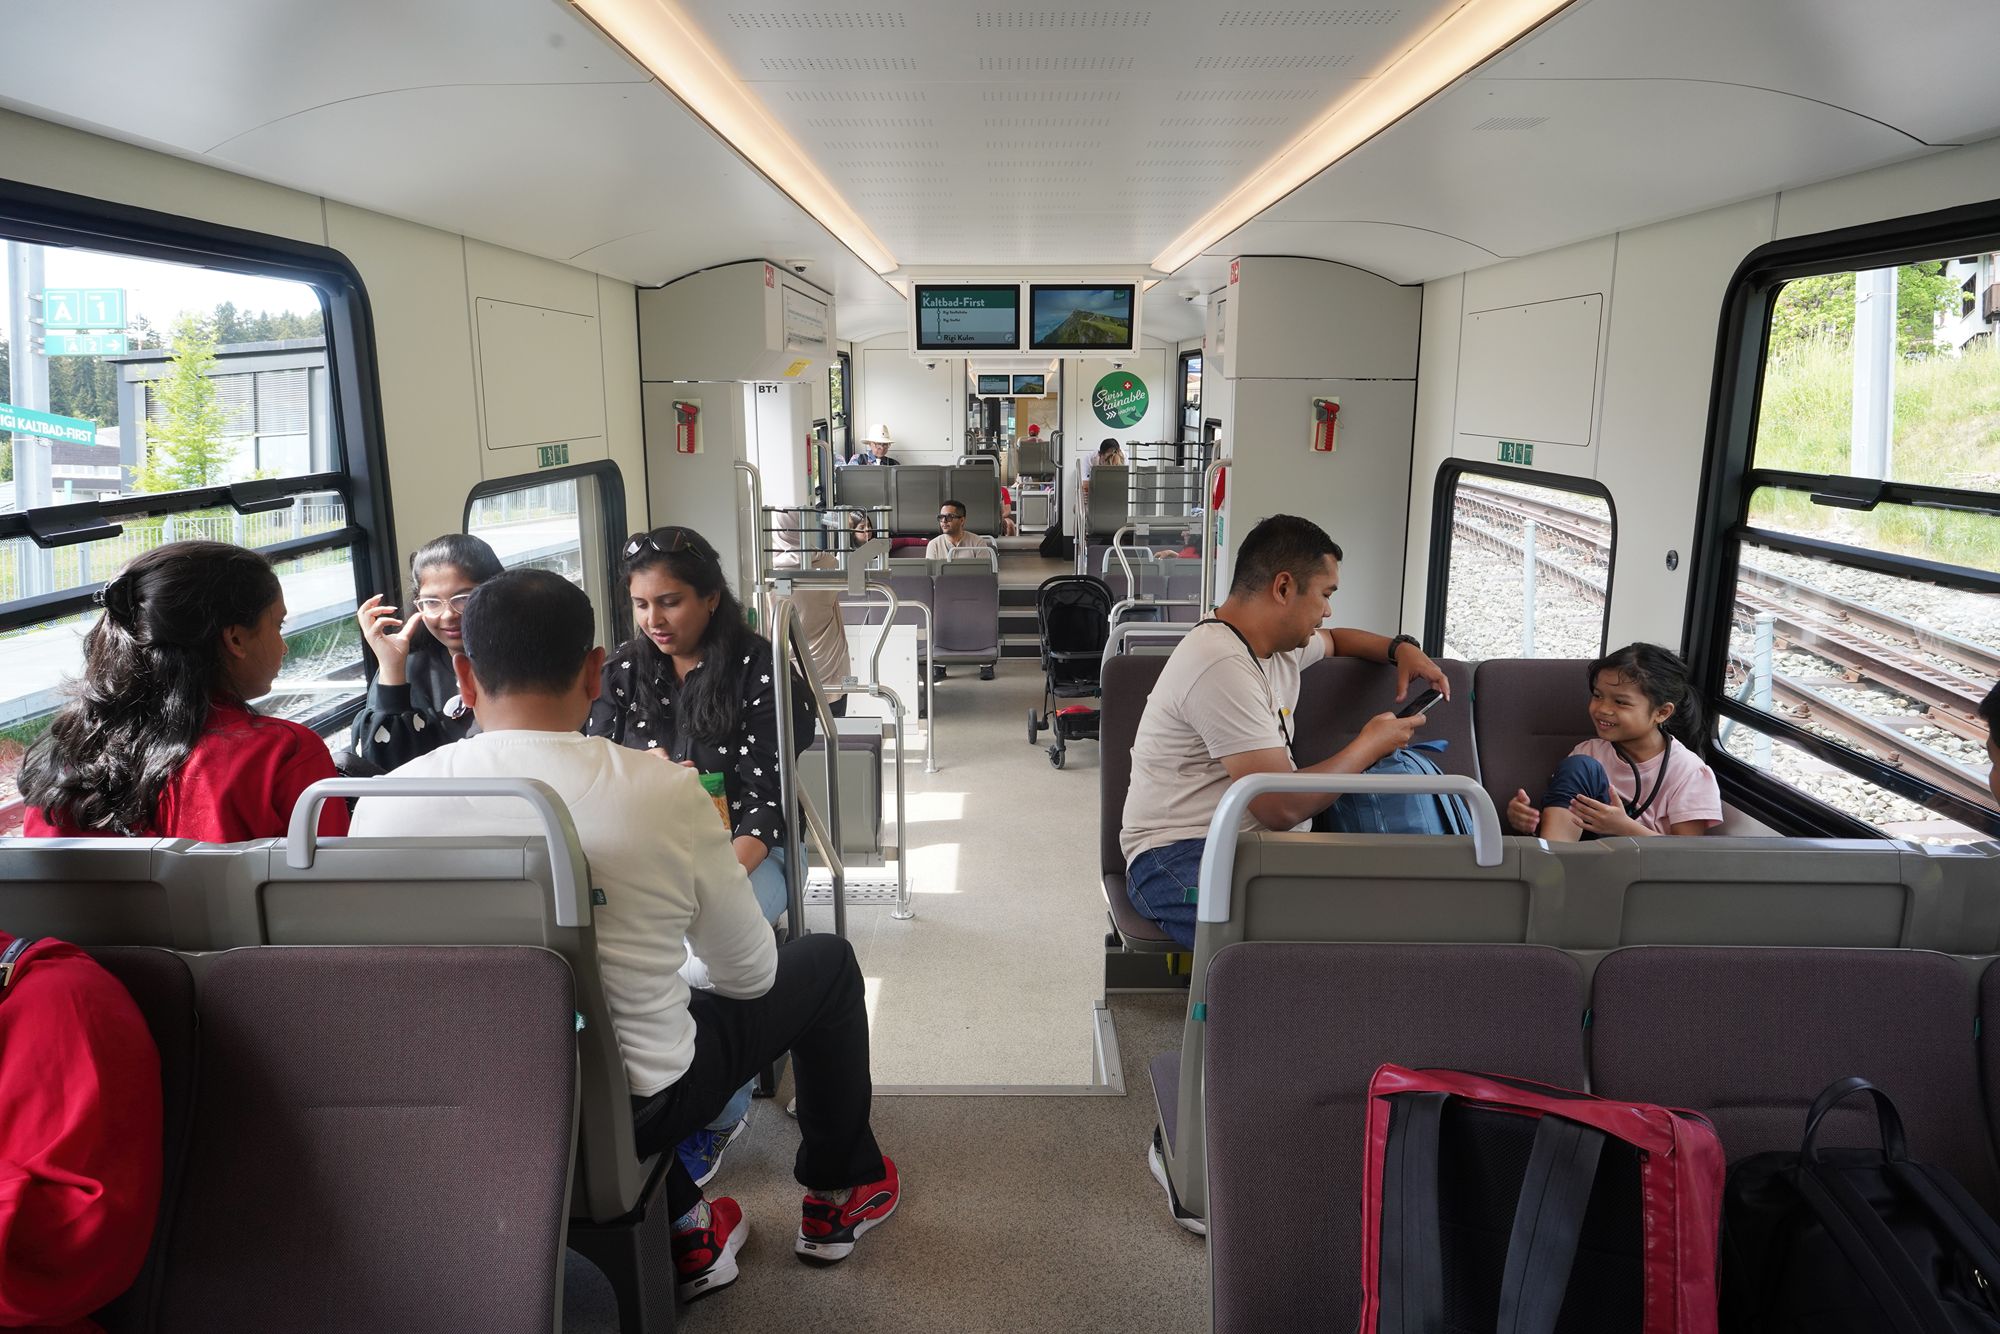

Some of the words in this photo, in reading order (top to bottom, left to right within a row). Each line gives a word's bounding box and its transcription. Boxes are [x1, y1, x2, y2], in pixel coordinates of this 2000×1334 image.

[54, 301, 72, 320] A
[96, 301, 105, 320] 1
[922, 297, 984, 307] Kaltbad-First
[943, 334, 956, 342] Rigi
[758, 385, 778, 393] BT1
[1094, 389, 1123, 407] Swiss
[1103, 390, 1145, 411] tainable
[0, 414, 16, 428] IGI
[17, 418, 92, 442] KALTBAD-FIRST
